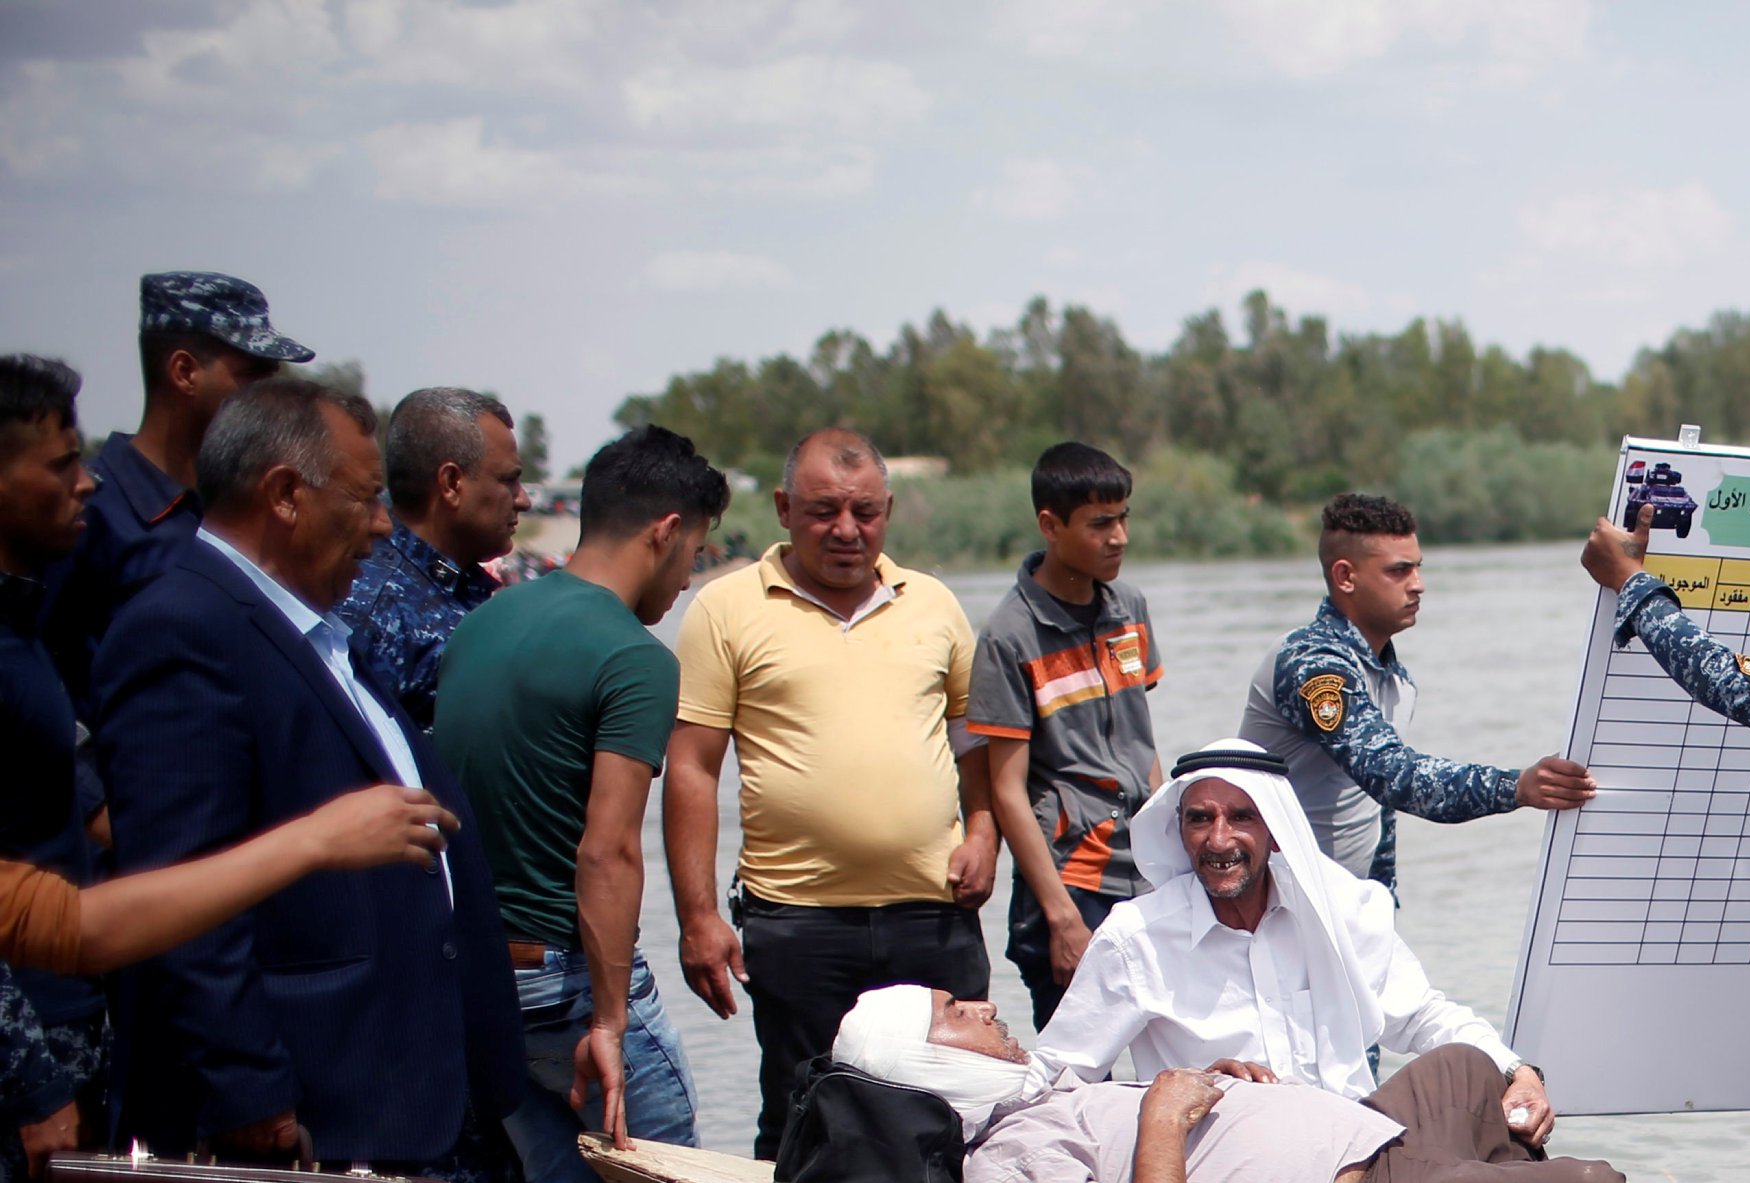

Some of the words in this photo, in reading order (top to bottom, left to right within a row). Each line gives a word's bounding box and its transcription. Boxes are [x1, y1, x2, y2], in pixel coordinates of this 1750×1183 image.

[1709, 487, 1746, 511] الأول
[1668, 576, 1710, 592] الموجود
[1719, 589, 1749, 606] مفقود
